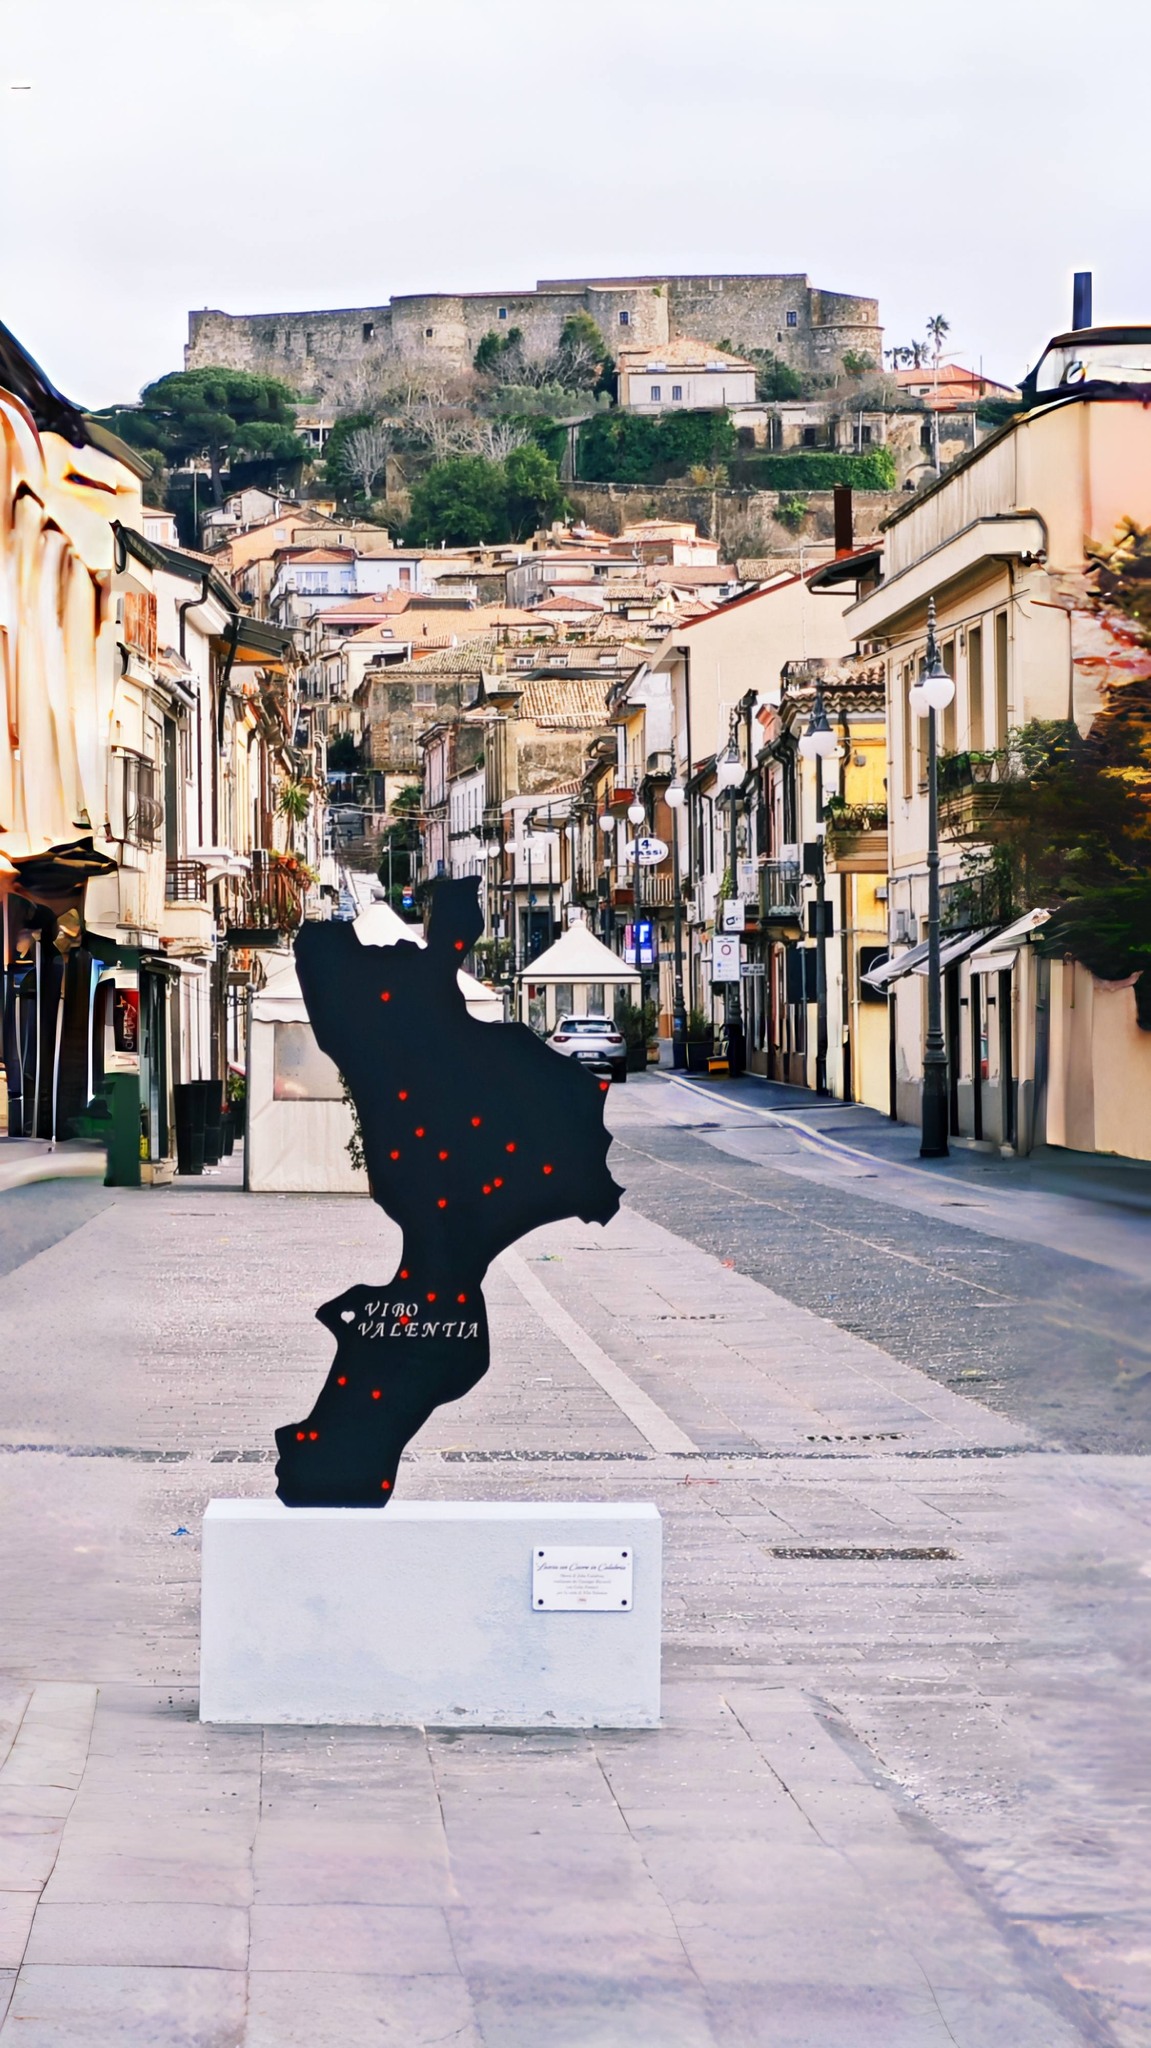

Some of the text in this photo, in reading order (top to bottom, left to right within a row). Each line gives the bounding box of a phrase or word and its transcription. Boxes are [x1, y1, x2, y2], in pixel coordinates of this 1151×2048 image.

[641, 839, 650, 849] 4
[364, 1300, 419, 1318] VIBO
[357, 1320, 479, 1340] VALENTIA
